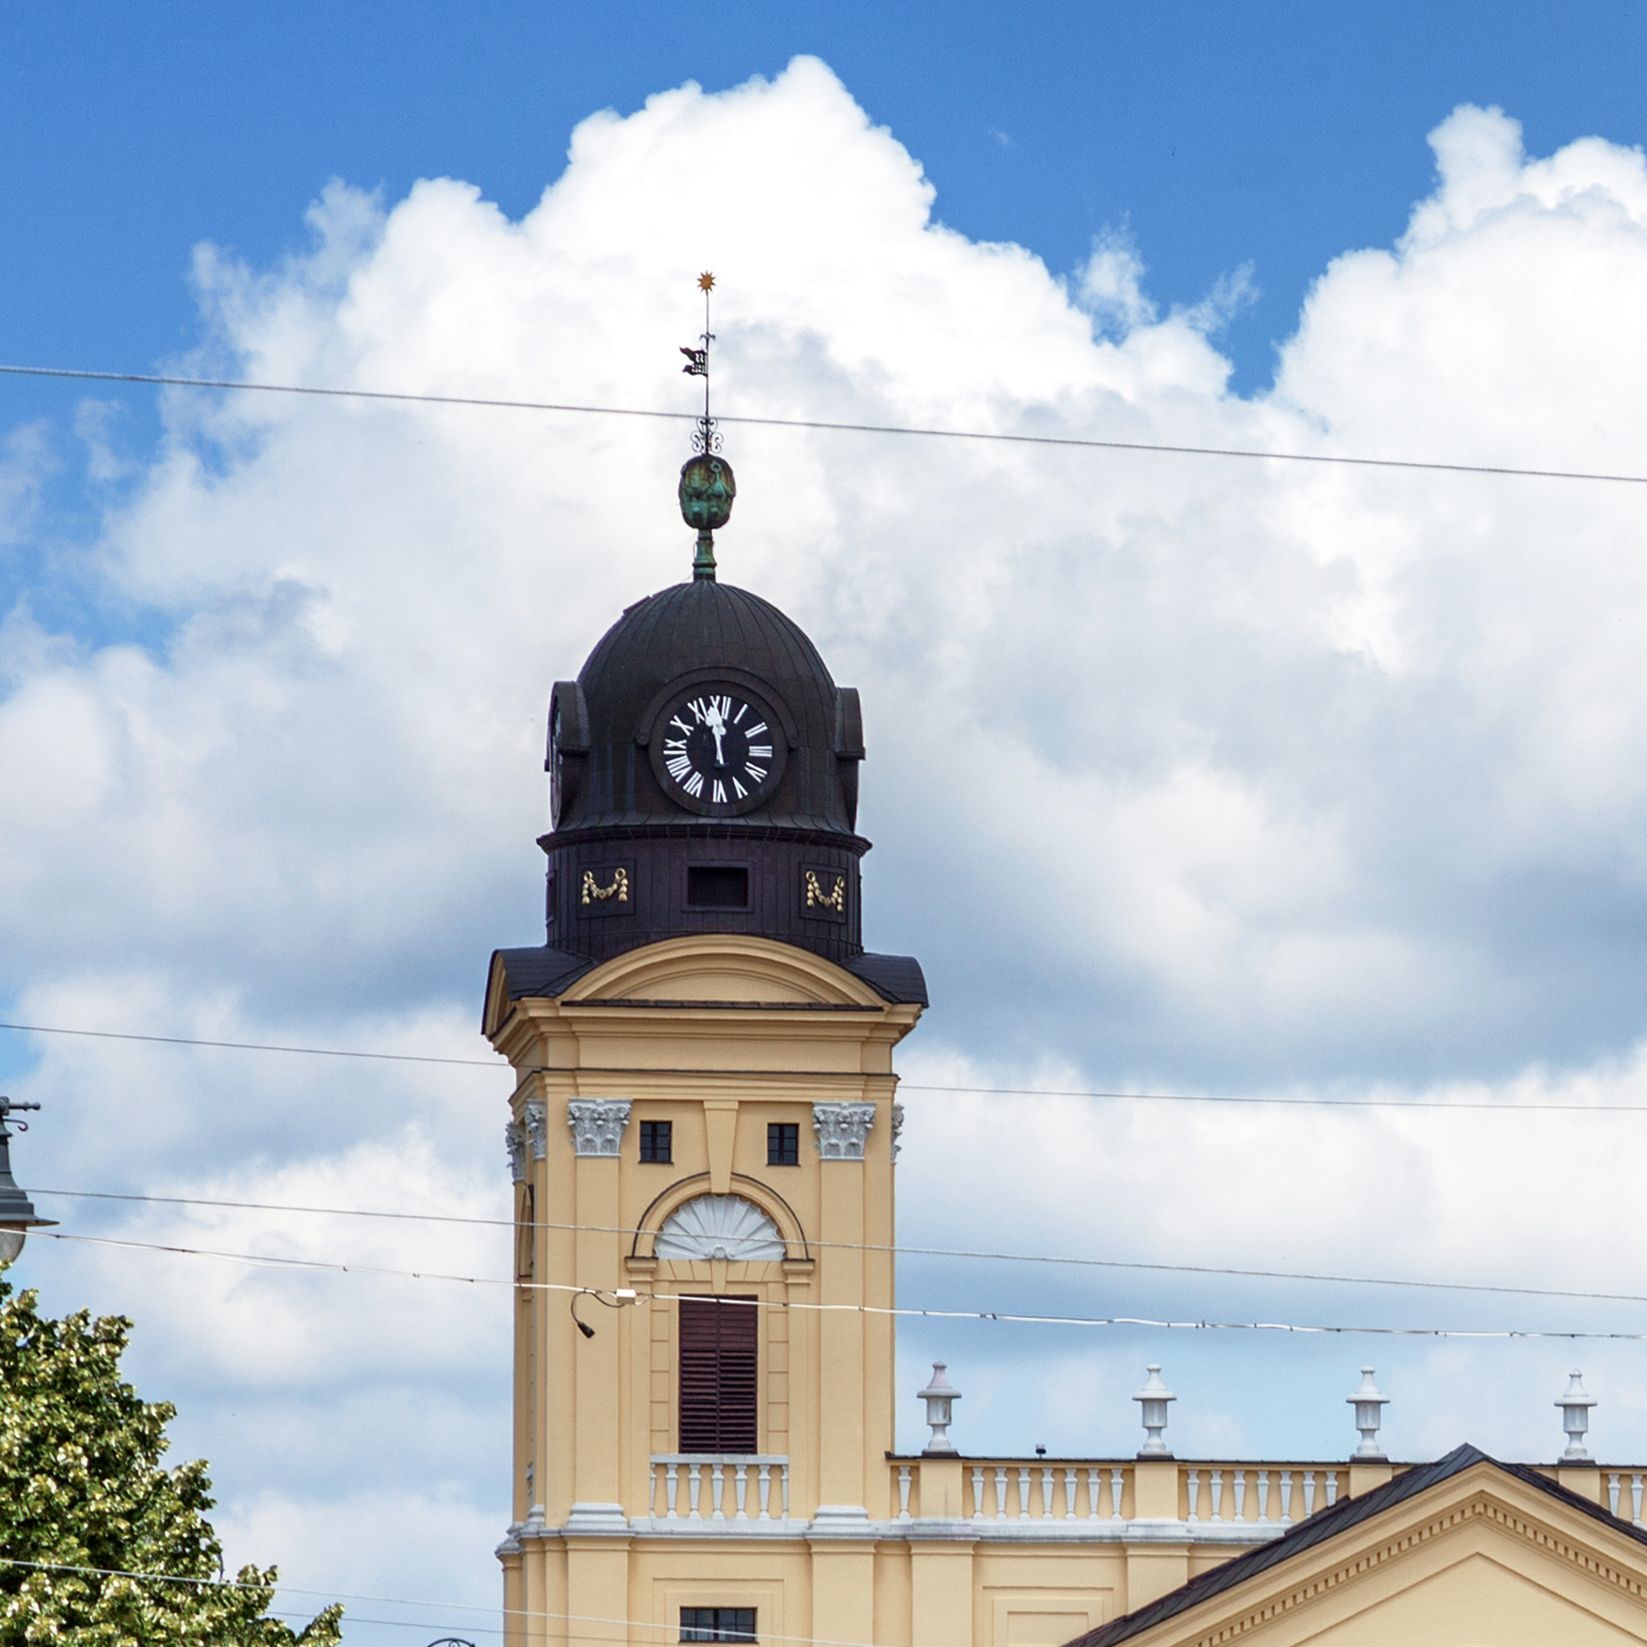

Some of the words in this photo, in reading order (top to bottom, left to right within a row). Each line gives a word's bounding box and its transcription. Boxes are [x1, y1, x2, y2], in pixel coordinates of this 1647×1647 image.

[687, 697, 707, 724] XI
[733, 703, 748, 724] I
[669, 715, 694, 736] X
[744, 722, 768, 739] II
[663, 739, 687, 755] IX
[749, 745, 773, 758] III
[665, 755, 693, 783] VIII
[744, 761, 768, 784] IV
[683, 771, 705, 798] VII
[713, 779, 728, 803] VI
[732, 776, 748, 799] V
